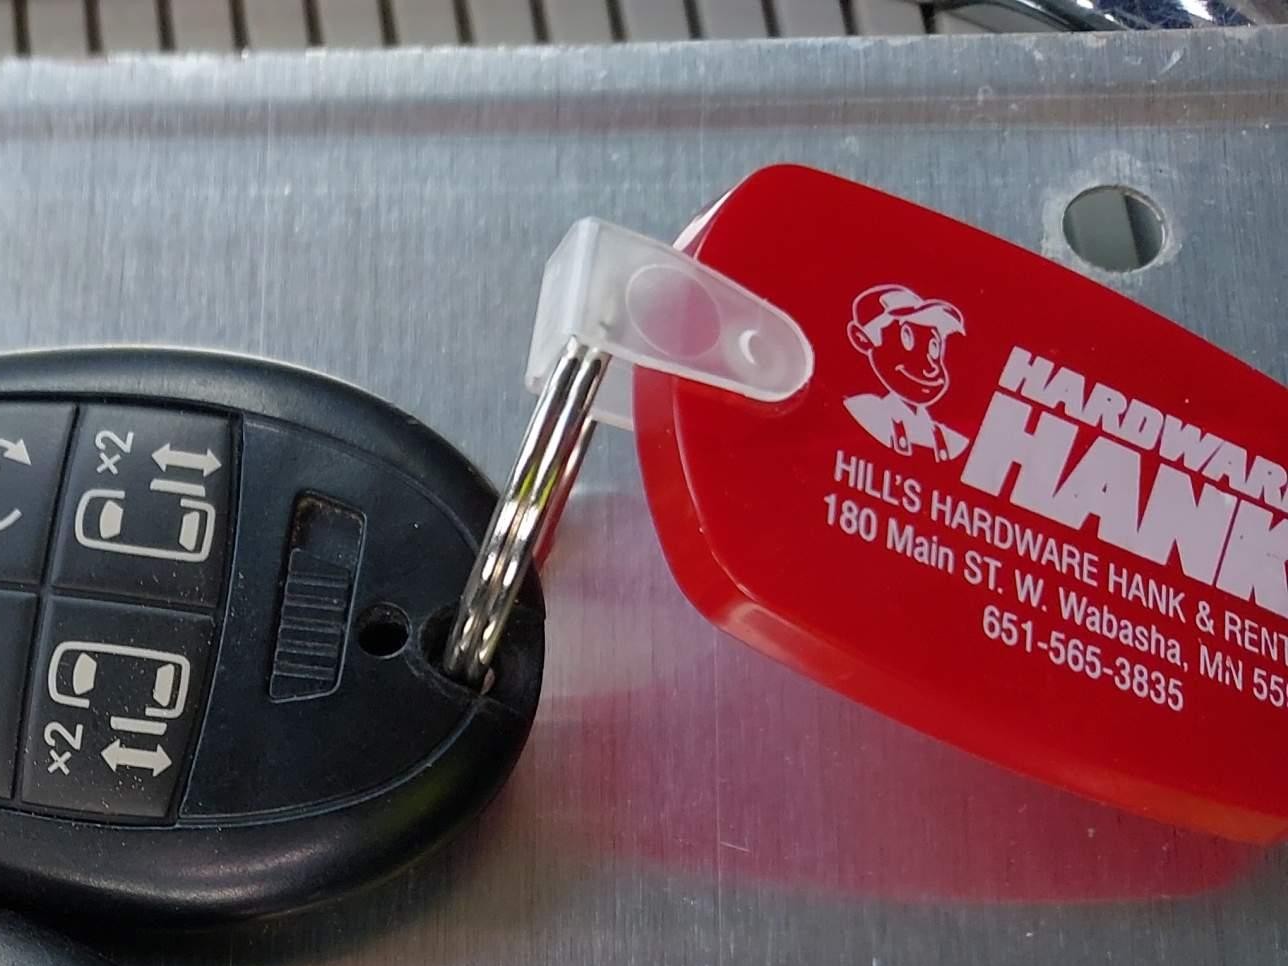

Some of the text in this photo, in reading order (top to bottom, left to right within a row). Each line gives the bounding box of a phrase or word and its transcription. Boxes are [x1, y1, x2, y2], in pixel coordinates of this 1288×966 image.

[96, 429, 135, 474] x2
[961, 391, 1288, 619] HANK
[998, 346, 1288, 515] HARDWAR
[824, 494, 1288, 708] 180 Main ST. W. Wabasha, MN 55
[834, 450, 921, 514] HILL'S
[930, 490, 1099, 587] HARDWARE
[1108, 562, 1186, 624] HANK
[1195, 600, 1215, 636] &
[982, 604, 1185, 712] 651-565-3835
[45, 722, 83, 775] x2
